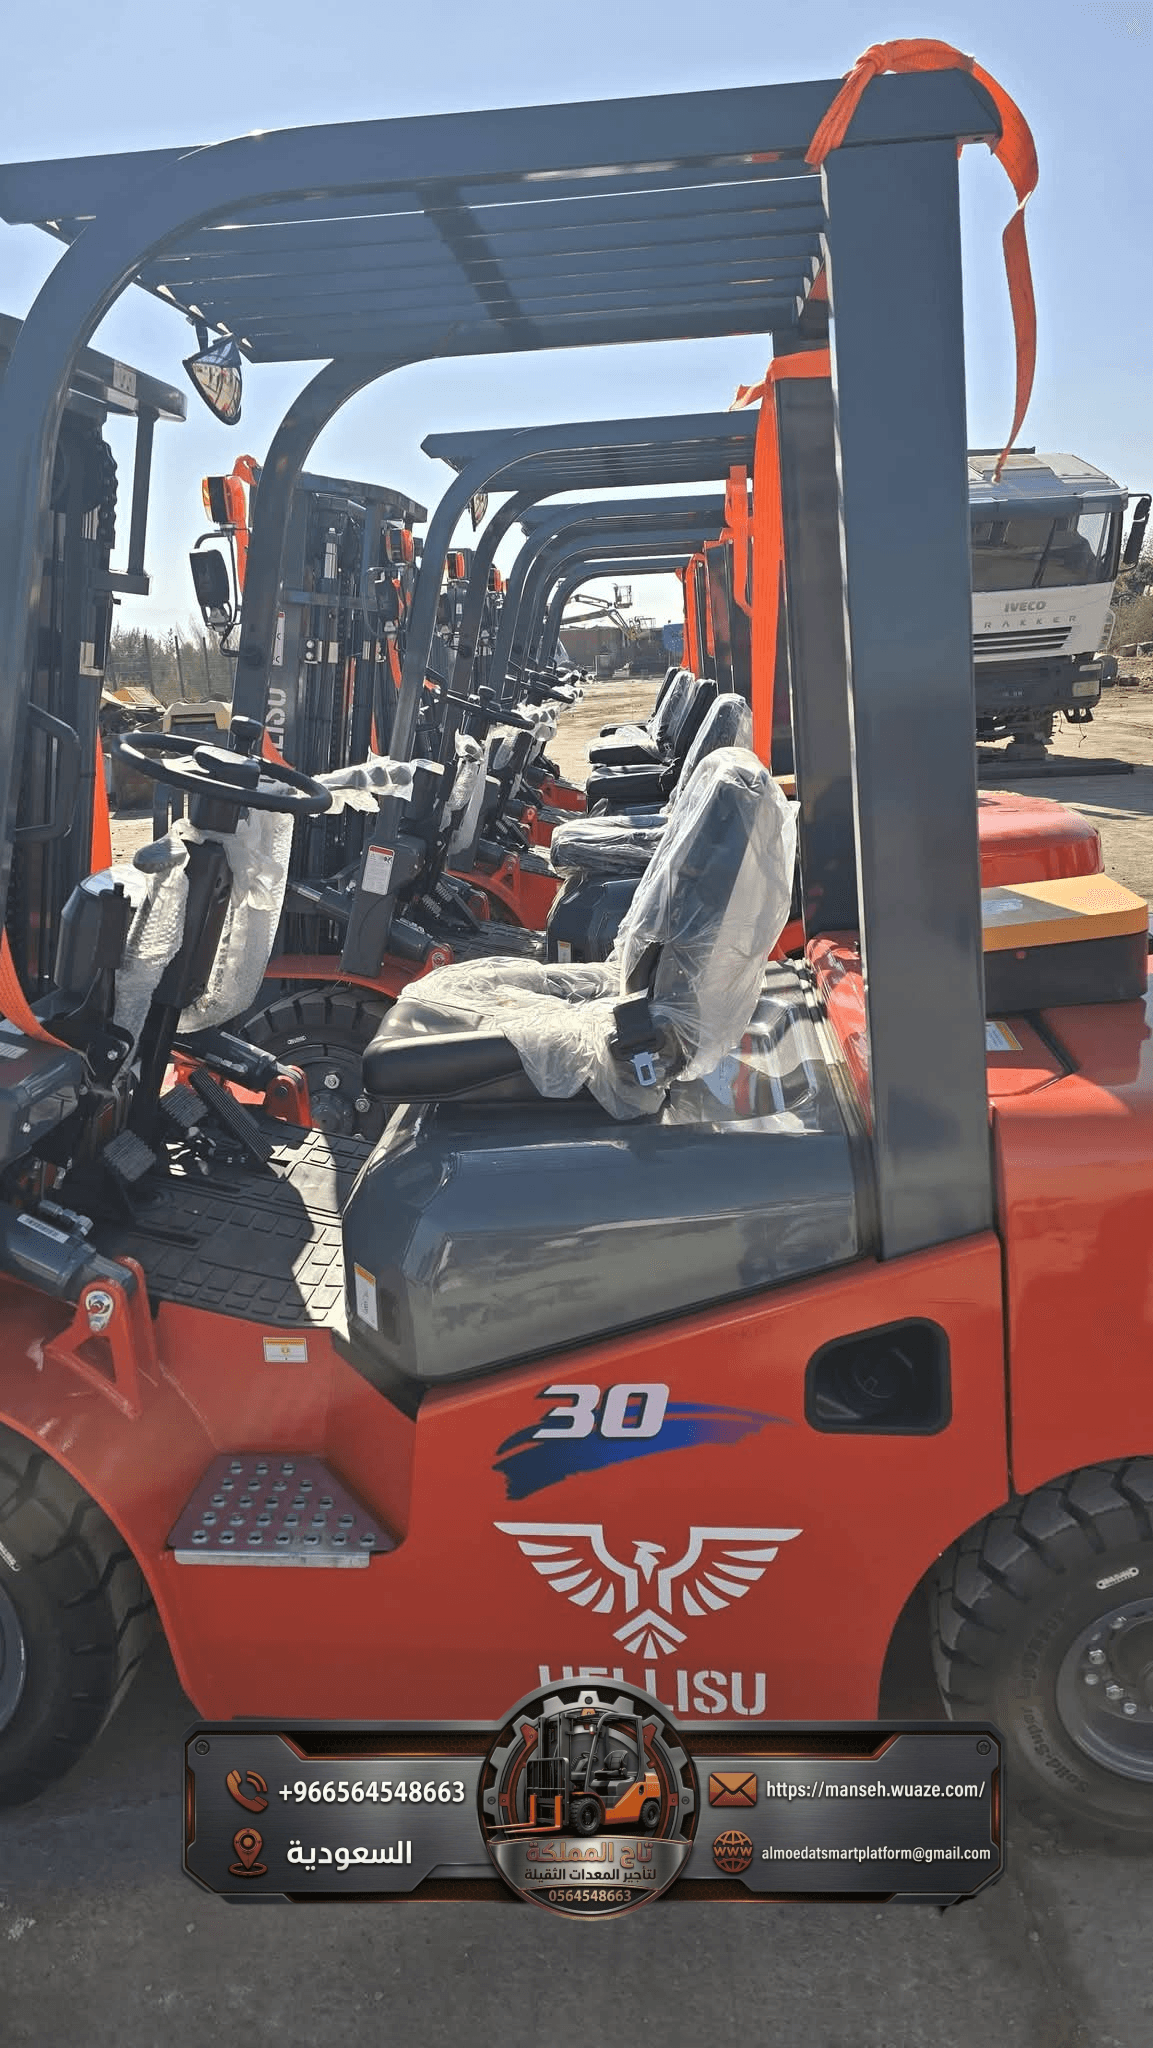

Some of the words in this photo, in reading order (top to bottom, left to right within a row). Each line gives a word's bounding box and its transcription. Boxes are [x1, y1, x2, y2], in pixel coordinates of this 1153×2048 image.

[1004, 600, 1047, 613] IVECO
[264, 687, 287, 758] LISU
[532, 1383, 670, 1439] 30
[538, 1665, 767, 1716] LISU
